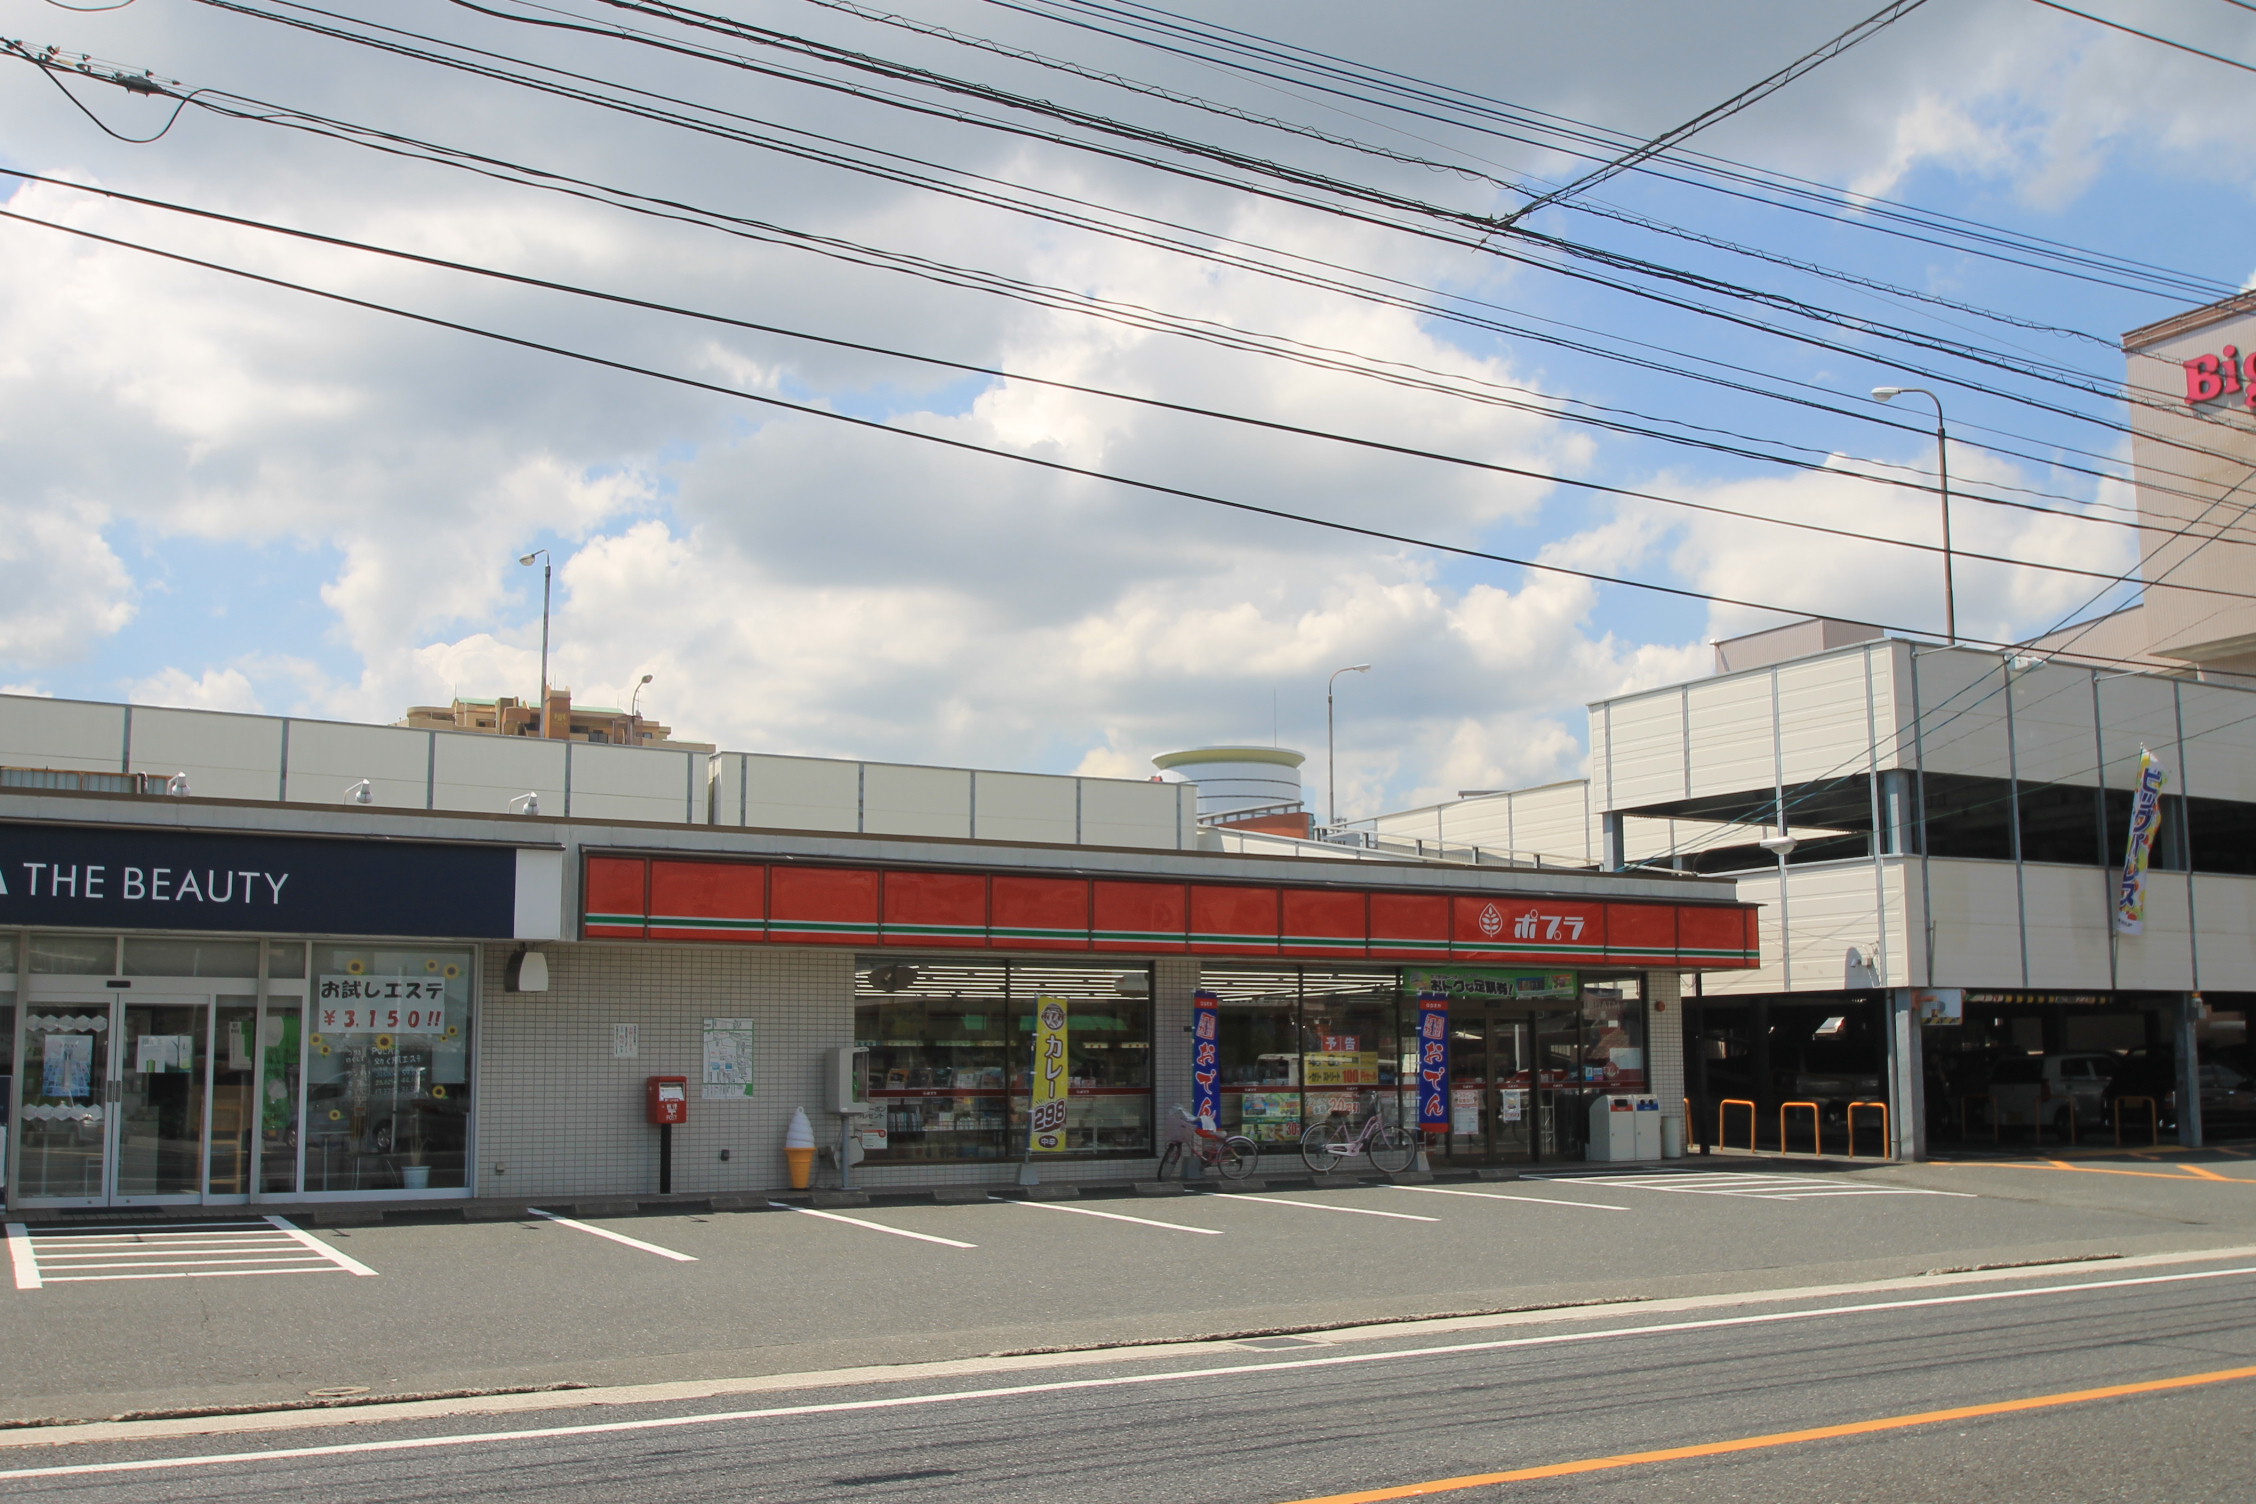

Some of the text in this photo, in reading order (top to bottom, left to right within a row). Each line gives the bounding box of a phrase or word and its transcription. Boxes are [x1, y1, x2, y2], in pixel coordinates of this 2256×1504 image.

[23, 862, 105, 898] THE
[123, 867, 289, 904] BEAUTY
[1514, 909, 1585, 941] ポプラ
[321, 980, 443, 1000] お試しエステ
[1324, 1036, 1356, 1050] 予告
[1044, 1033, 1064, 1100] カレー
[1343, 1069, 1359, 1083] 100
[1423, 1041, 1445, 1117] おでん
[1032, 1099, 1067, 1132] 298
